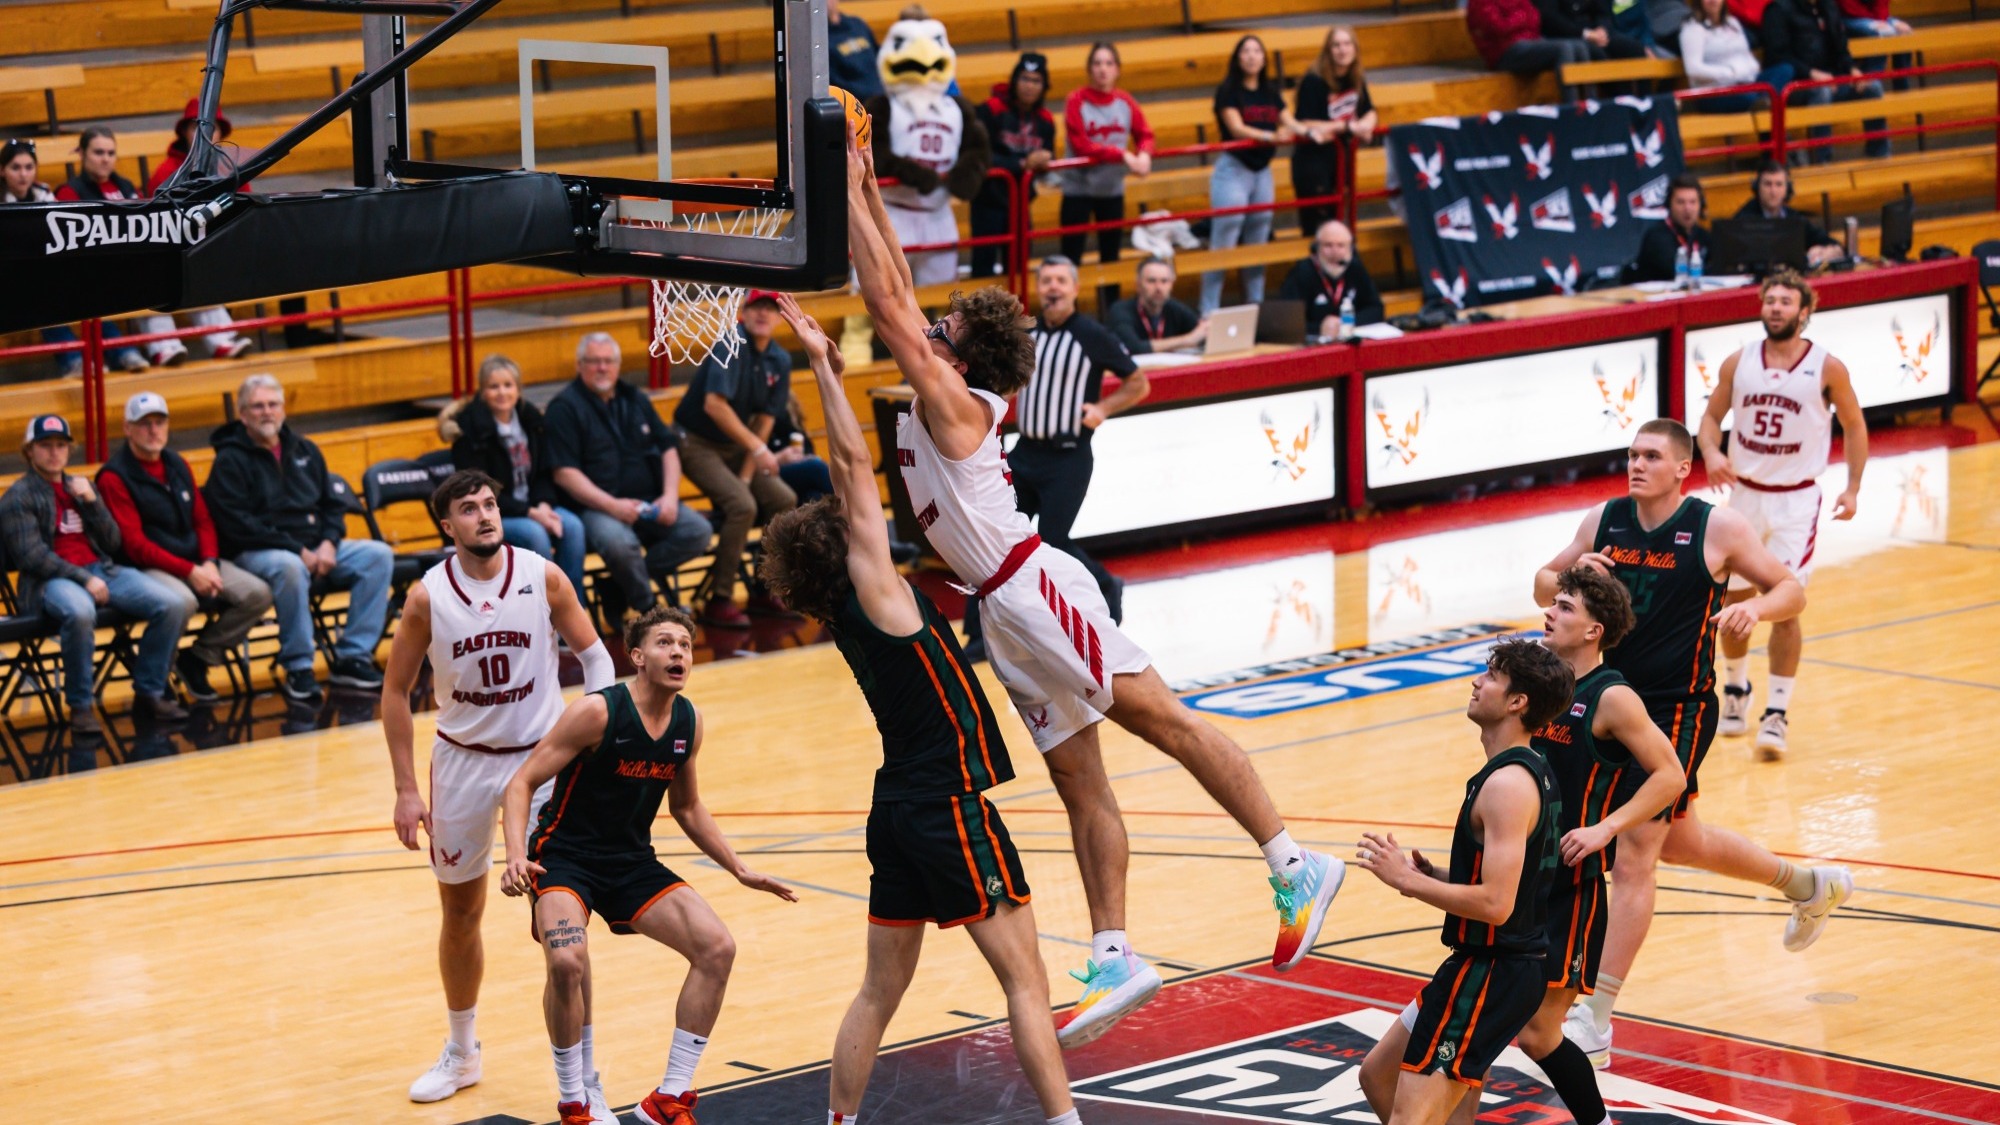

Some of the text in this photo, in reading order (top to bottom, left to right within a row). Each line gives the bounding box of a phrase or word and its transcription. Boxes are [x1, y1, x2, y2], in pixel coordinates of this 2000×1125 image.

[45, 203, 206, 255] SPALDING
[1742, 393, 1802, 415] EASTERN
[1754, 411, 1784, 438] 55
[377, 469, 428, 485] EASTERN
[1610, 546, 1677, 569] Walla Walla
[452, 630, 532, 660] EASTERN
[478, 653, 511, 688] 10
[452, 677, 536, 707] WASHINGTON
[1544, 721, 1573, 745] Walla
[615, 759, 648, 778] Walla
